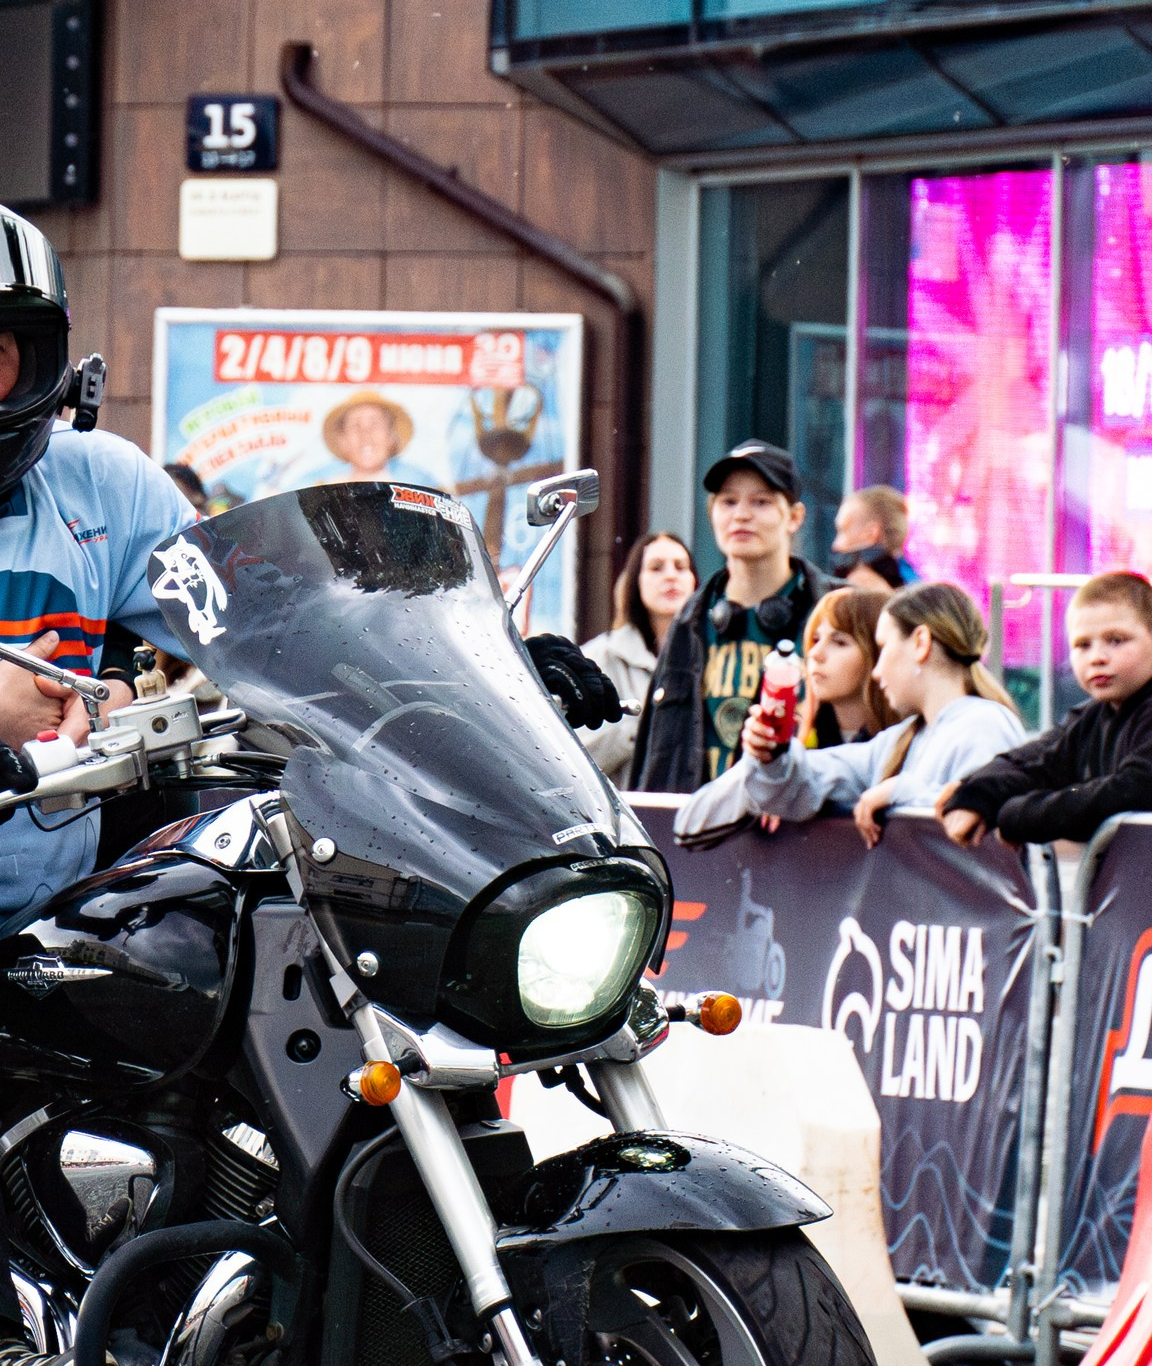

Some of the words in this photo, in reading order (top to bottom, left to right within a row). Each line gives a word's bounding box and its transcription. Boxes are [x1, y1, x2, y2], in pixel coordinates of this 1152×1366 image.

[202, 103, 257, 149] 15
[219, 334, 372, 382] 2/4/8/9
[886, 920, 985, 1014] SIMA
[880, 1012, 984, 1103] LAND
